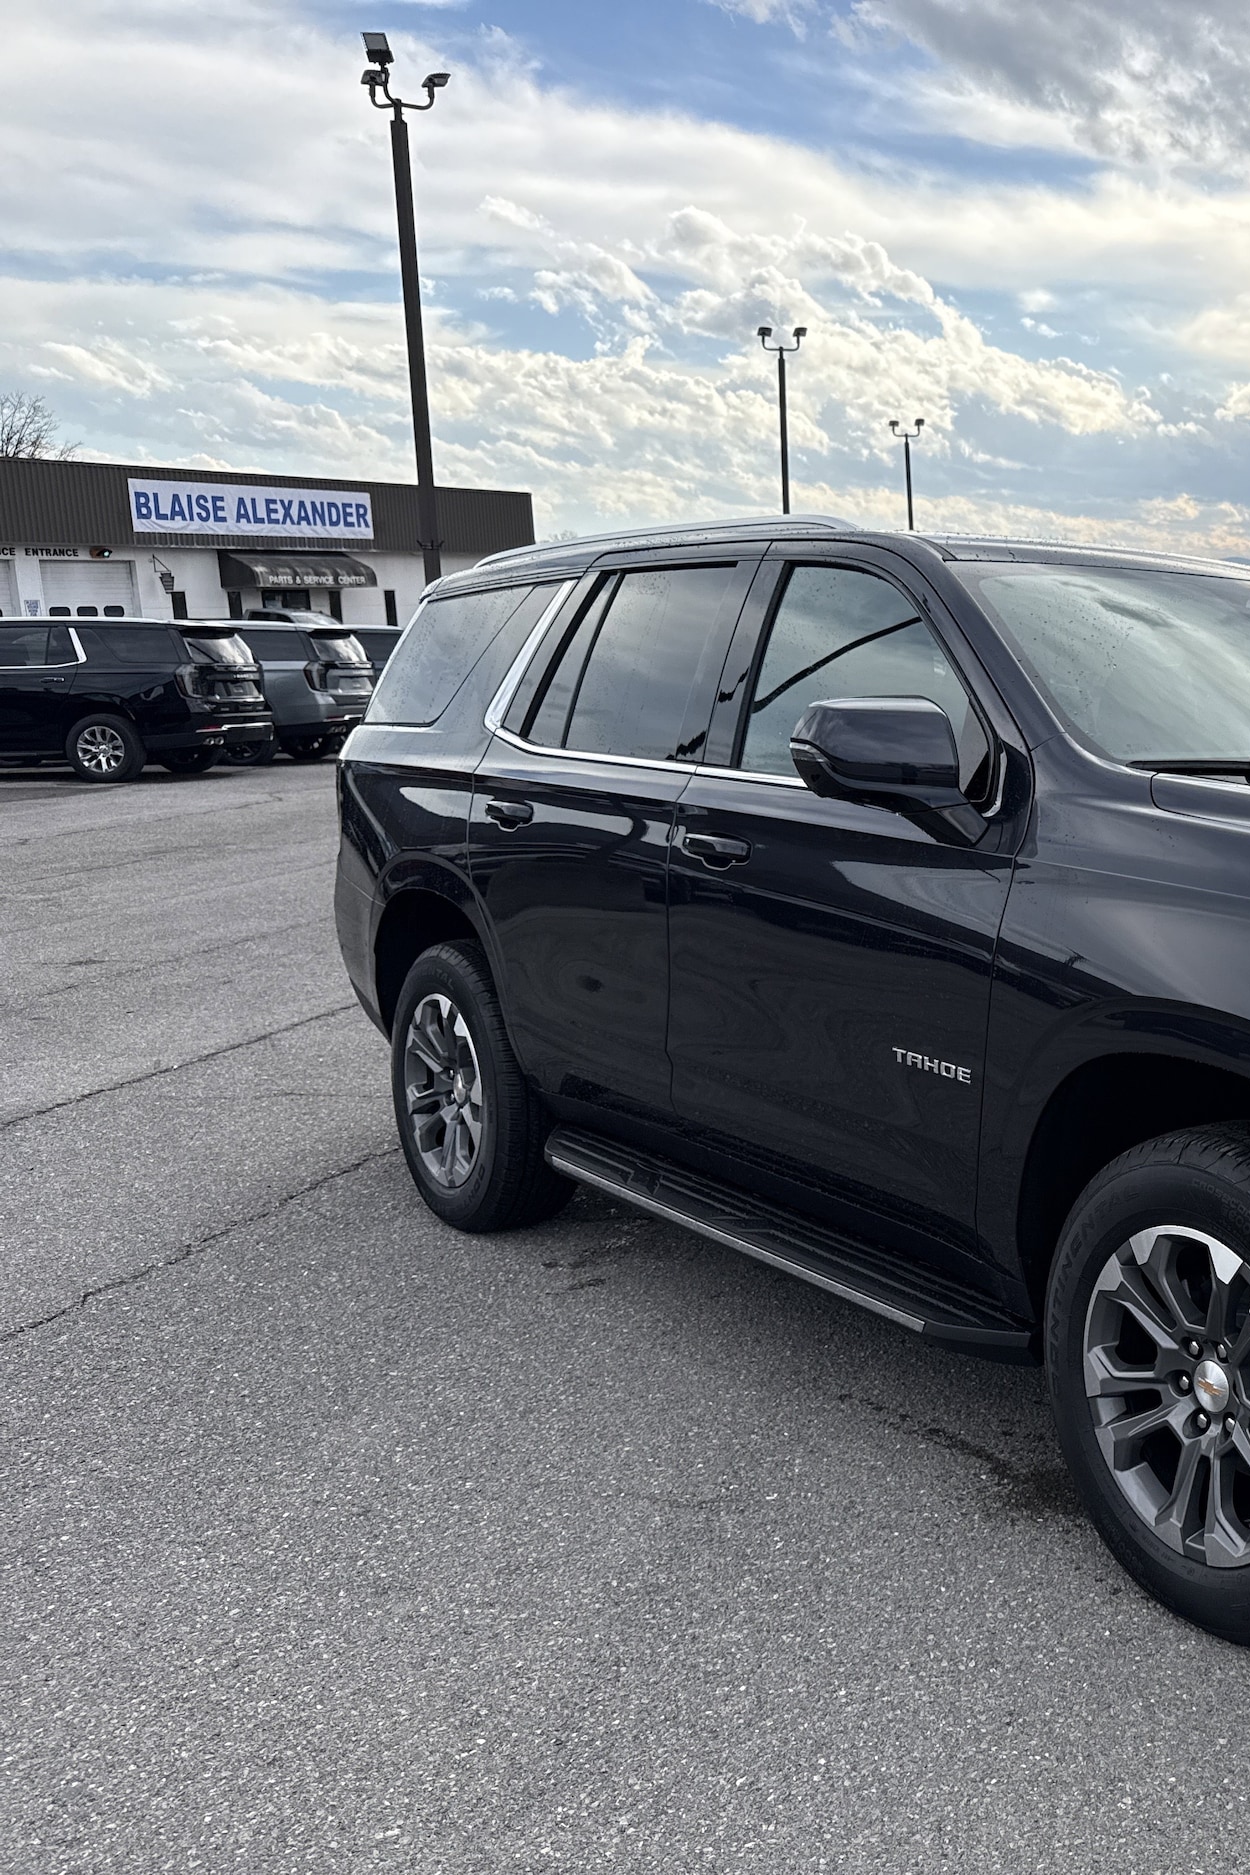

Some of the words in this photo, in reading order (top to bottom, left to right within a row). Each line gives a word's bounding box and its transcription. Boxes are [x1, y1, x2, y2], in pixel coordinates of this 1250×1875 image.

[134, 491, 227, 523] BLAISE
[235, 496, 371, 529] ALEXANDER
[24, 547, 79, 557] ENTRANCE
[268, 575, 294, 585] PARTS
[296, 575, 302, 585] &
[303, 575, 335, 585] SERVICE
[337, 575, 366, 585] CENTER
[891, 1046, 971, 1084] TAHOE
